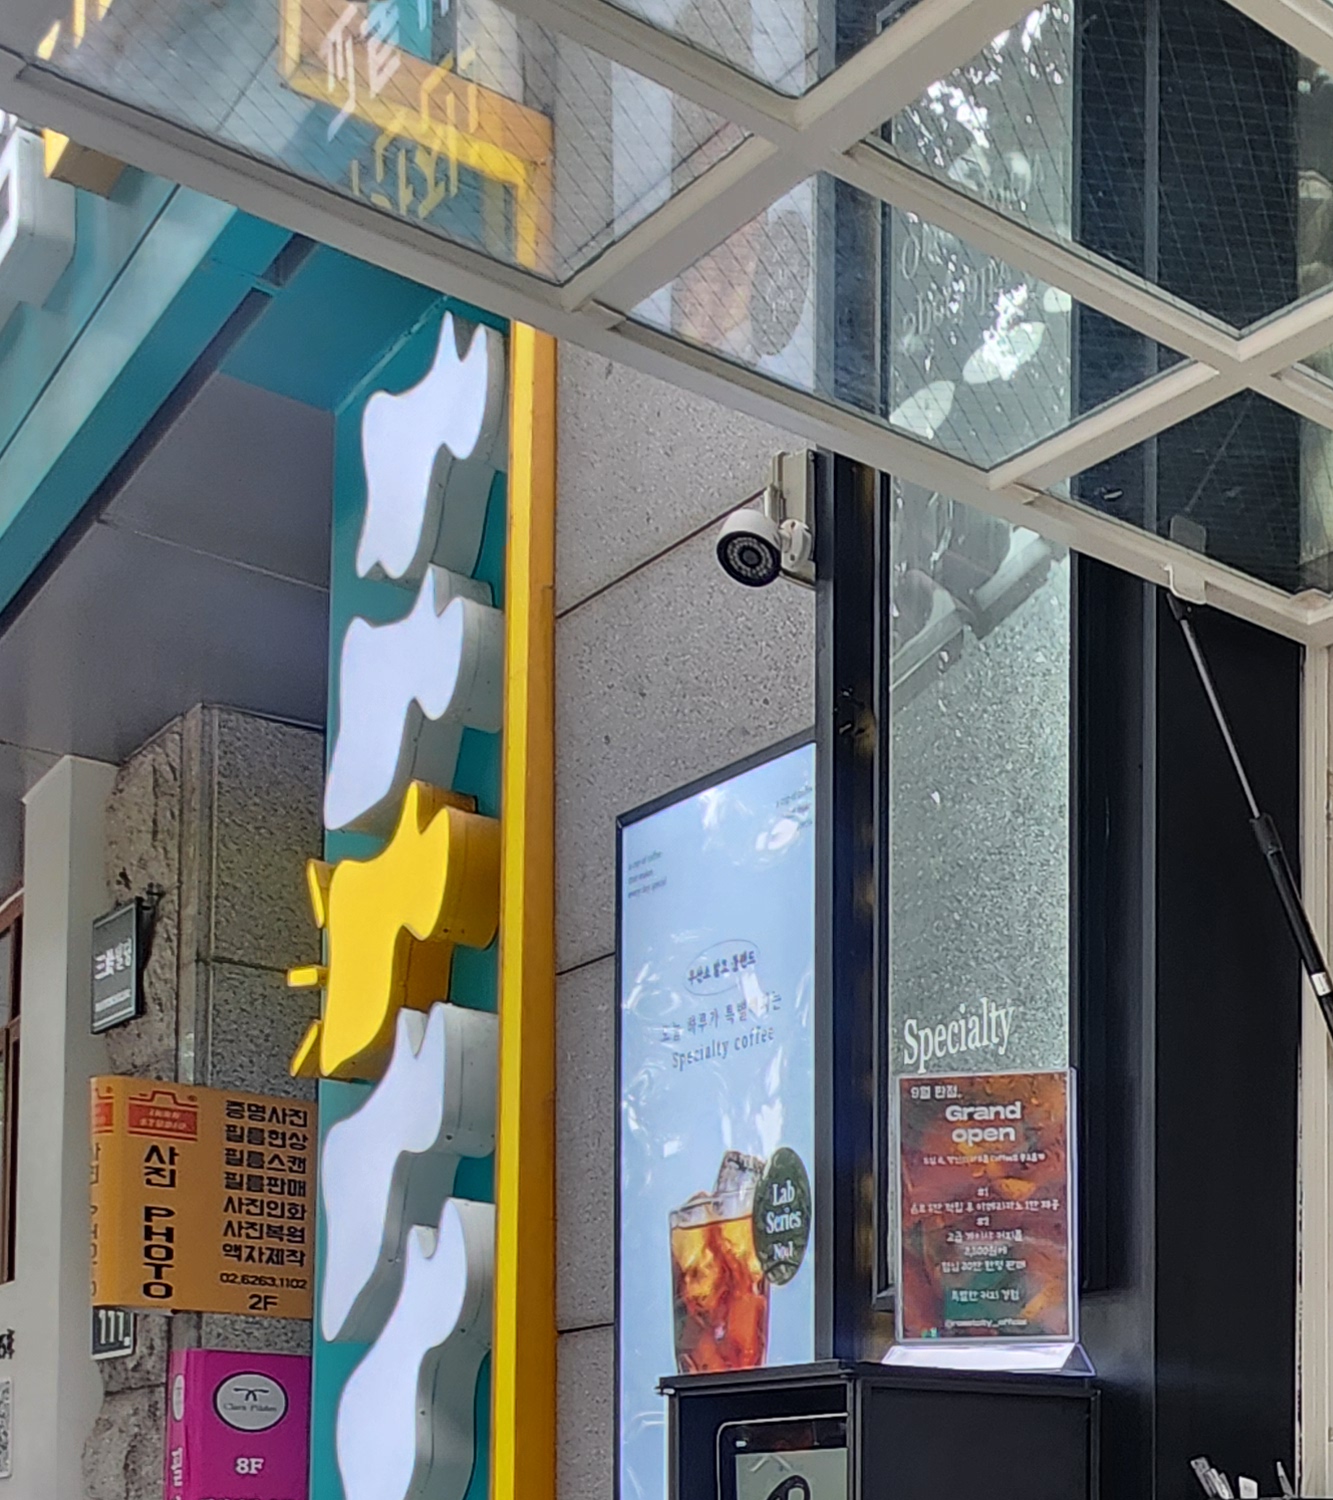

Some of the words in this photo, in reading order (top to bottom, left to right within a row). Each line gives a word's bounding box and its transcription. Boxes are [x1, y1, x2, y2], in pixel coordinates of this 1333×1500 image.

[903, 997, 1015, 1074] Specialty
[226, 1100, 308, 1128] 증명사진
[945, 1101, 1022, 1122] Grand
[225, 1124, 308, 1151] 필름현상
[952, 1126, 1016, 1147] open
[144, 1144, 179, 1188] 사진
[225, 1148, 307, 1175] 필름스캔
[224, 1172, 306, 1198] 필름판매
[772, 1180, 796, 1206] Lab
[224, 1195, 307, 1221] 사진인화
[766, 1208, 802, 1234] Series
[223, 1220, 305, 1244] 사진복원
[143, 1206, 176, 1300] PHOTO
[222, 1243, 306, 1267] 액자제작
[249, 1294, 278, 1310] 2F
[235, 1458, 264, 1474] 8F
